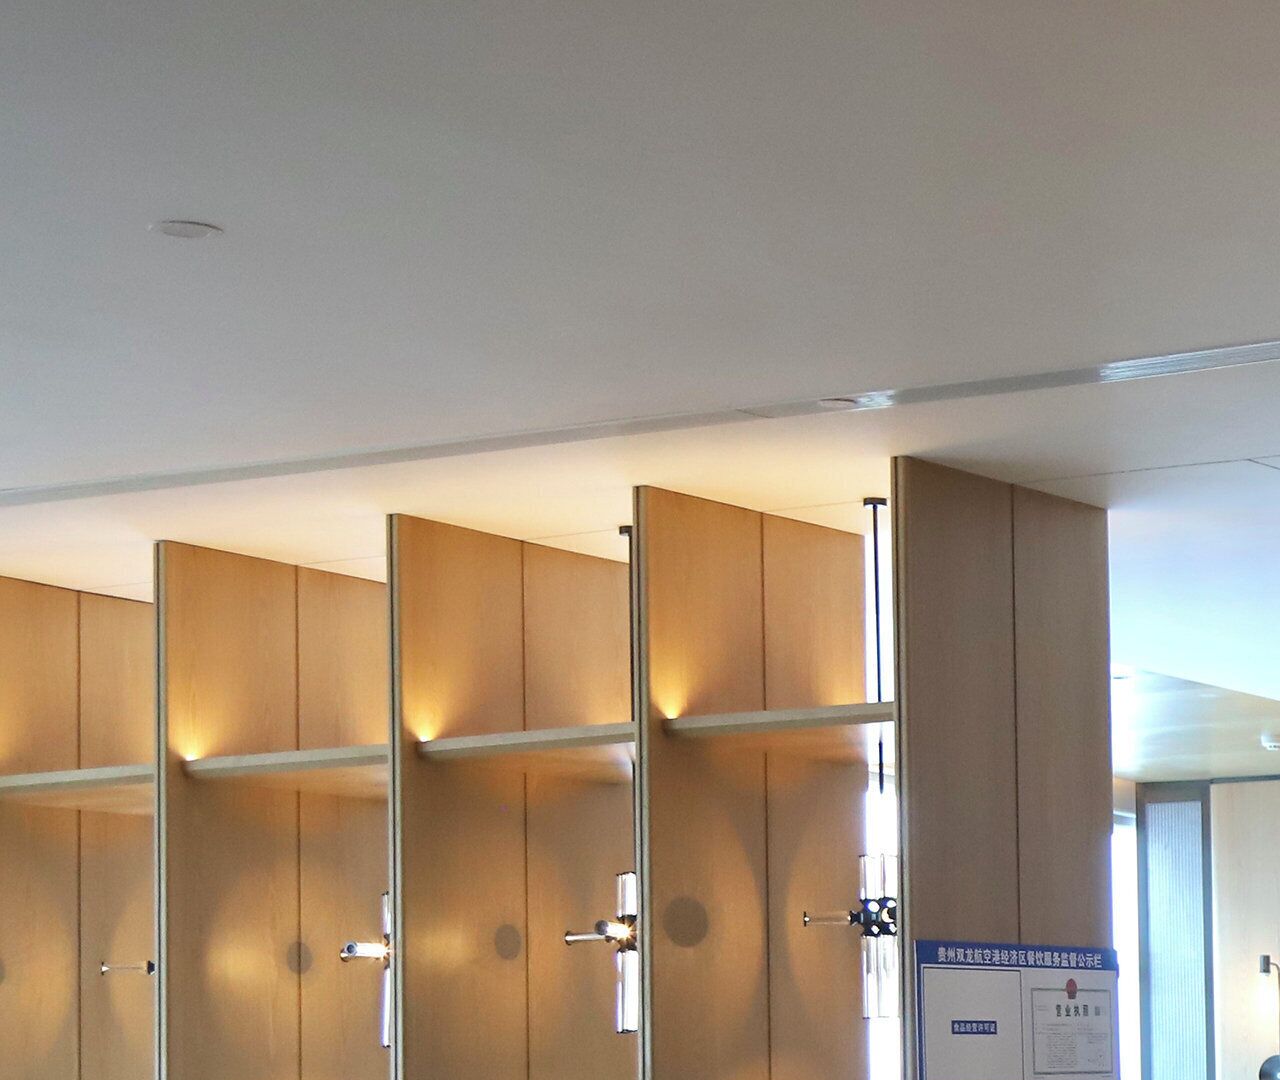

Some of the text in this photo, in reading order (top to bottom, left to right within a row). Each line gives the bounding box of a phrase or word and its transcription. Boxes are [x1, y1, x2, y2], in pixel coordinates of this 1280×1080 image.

[937, 946, 1102, 968] 贵州双龙航空港经济区餐饮服务监督公示栏
